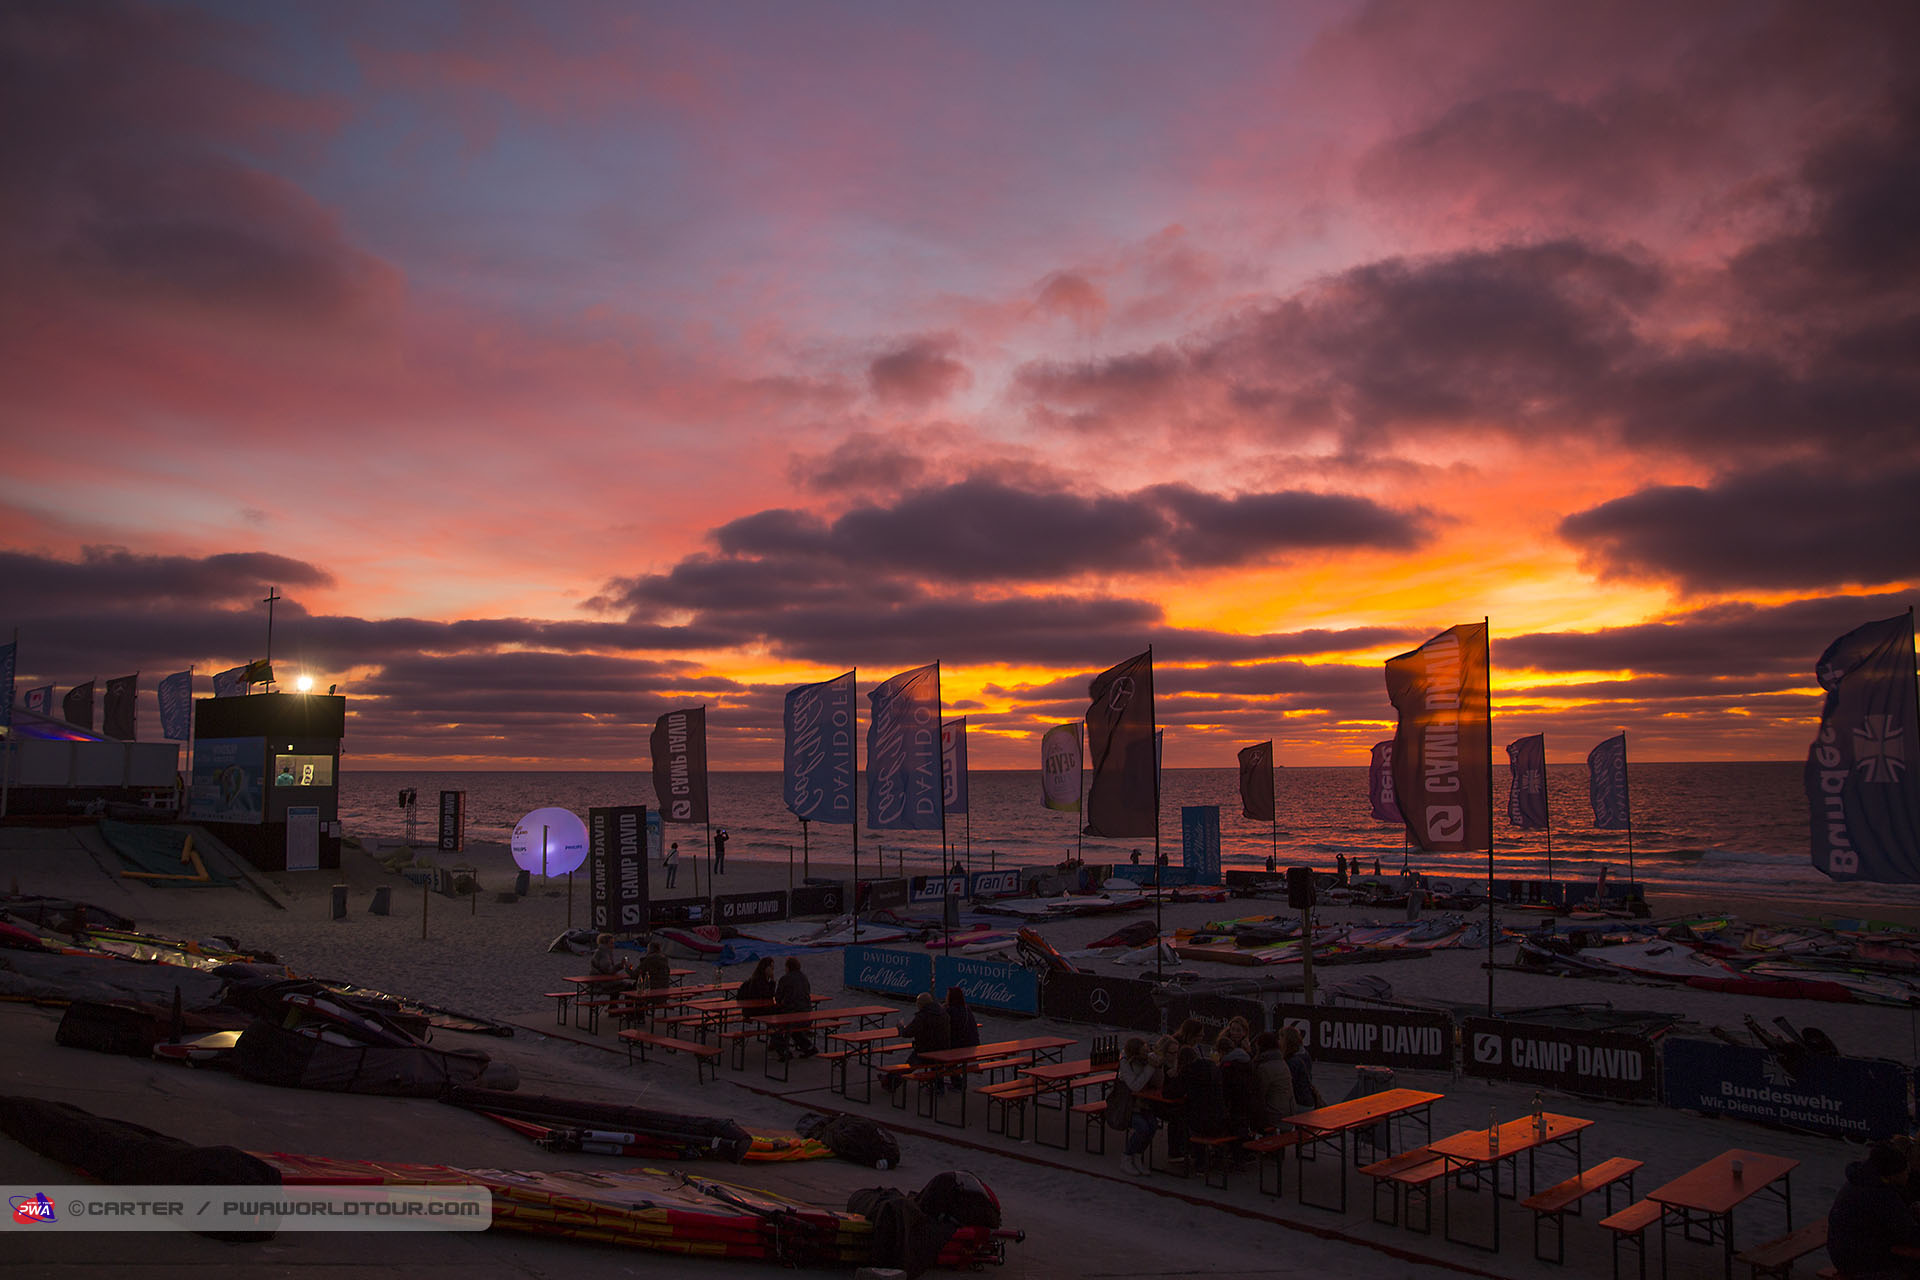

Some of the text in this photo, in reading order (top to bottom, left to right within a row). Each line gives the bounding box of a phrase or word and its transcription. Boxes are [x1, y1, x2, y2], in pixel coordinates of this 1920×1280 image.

[594, 815, 606, 900] CAMP DAVID
[620, 813, 639, 899] CAMP DAVID
[978, 876, 1000, 889] ran
[736, 899, 779, 916] CAMP DAVID
[863, 951, 911, 967] DAVIDOFF
[957, 962, 1014, 980] DAVIDOFF
[859, 966, 913, 987] Cool Water
[975, 980, 1016, 1003] Water
[1319, 1020, 1442, 1055] CAMP DAVID
[1511, 1038, 1643, 1081] CAMP DAVID
[1721, 1081, 1842, 1112] Bundeswehr
[1700, 1092, 1871, 1132] Wir. Dienen. Deutschland.
